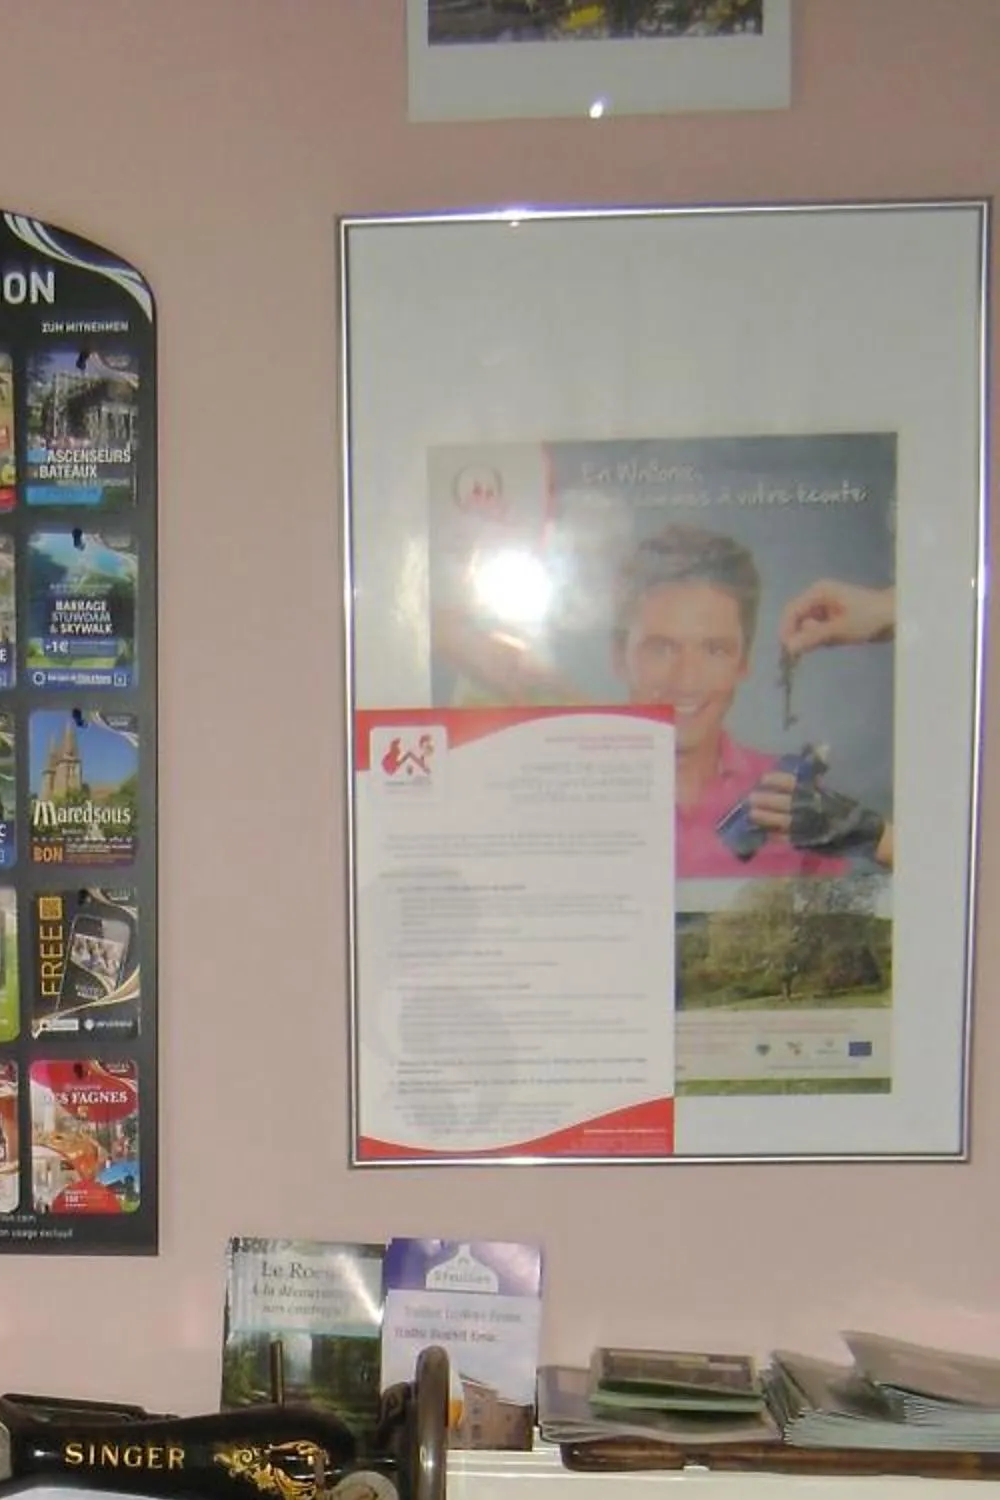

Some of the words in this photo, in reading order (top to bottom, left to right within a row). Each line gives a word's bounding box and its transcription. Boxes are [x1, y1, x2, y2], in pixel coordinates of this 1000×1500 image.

[41, 320, 64, 333] ZUM
[66, 320, 129, 333] MITNEHMEN
[47, 448, 131, 464] ASCENSEURS
[39, 463, 98, 479] BATEAUX
[55, 600, 106, 611] BARRAGE
[52, 611, 111, 623] STUWDAM
[60, 622, 113, 634] SKYWALK
[32, 799, 132, 826] Maredsous
[39, 922, 65, 997] FREE
[70, 1090, 128, 1104] FAGNES
[261, 1260, 282, 1278] Le
[64, 1441, 186, 1471] SINGER
